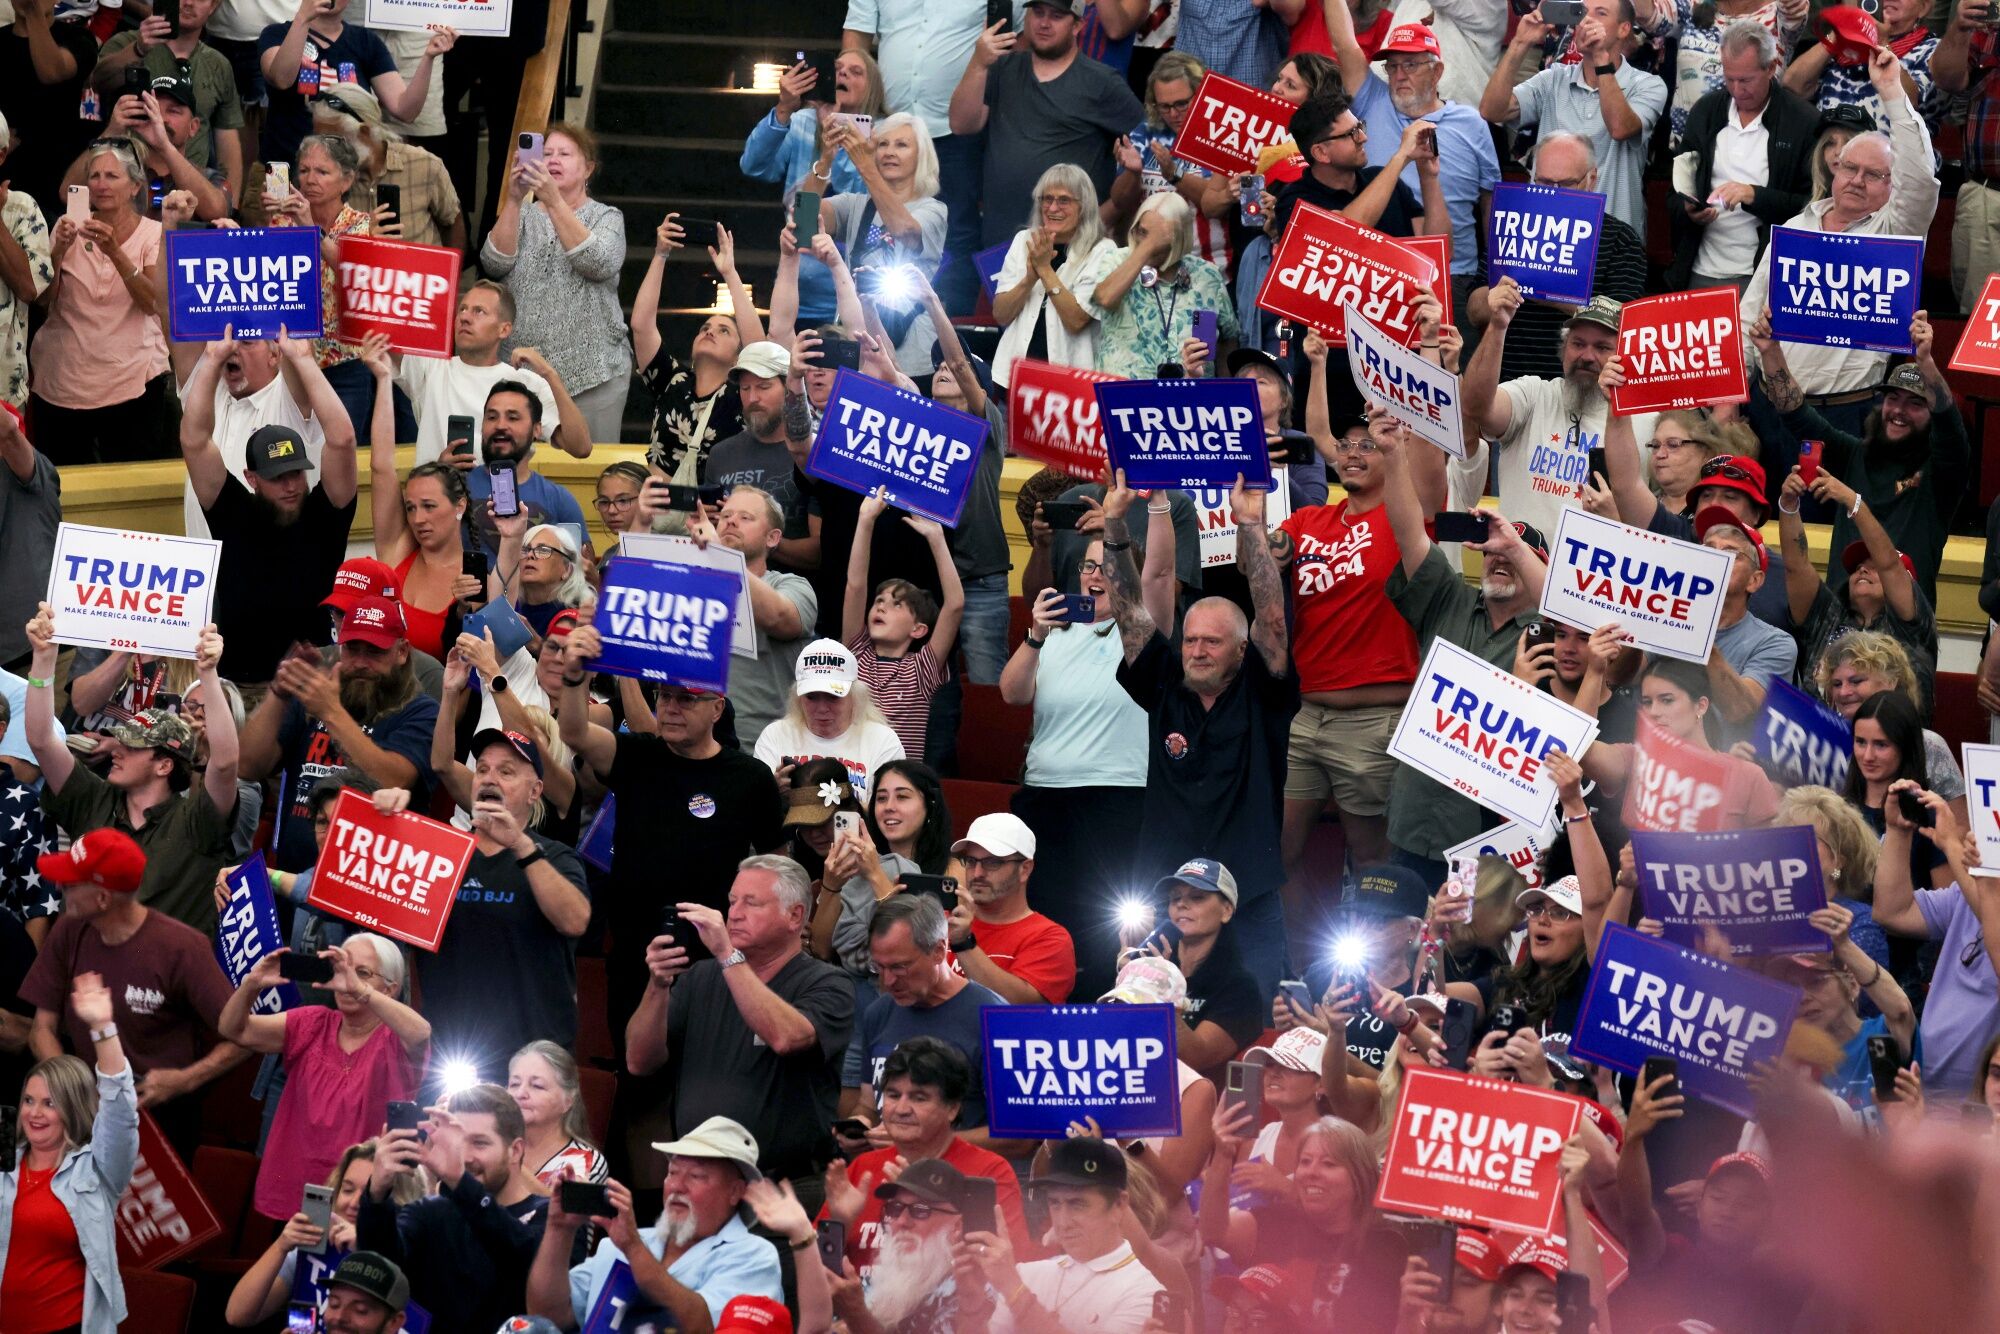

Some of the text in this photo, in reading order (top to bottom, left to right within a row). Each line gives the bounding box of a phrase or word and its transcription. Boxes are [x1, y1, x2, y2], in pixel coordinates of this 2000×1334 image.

[407, 1, 440, 9] AMERICA
[1204, 96, 1294, 146] TRUM
[1195, 136, 1248, 161] MAKE AMERICA
[1209, 122, 1264, 158] VAN
[1357, 227, 1384, 243] 2024
[1495, 211, 1592, 245] TRUMP
[1498, 237, 1575, 265] VANCE
[1503, 260, 1526, 268] AMERICA
[1529, 263, 1551, 272] GREAT
[1553, 267, 1578, 275] AGAIN!
[178, 256, 312, 283] TRUMP
[340, 262, 449, 300] TRUMP
[1302, 245, 1405, 302] VANCE
[1778, 256, 1910, 294] TRUMP
[195, 282, 299, 304] VANCE
[347, 289, 432, 320] VANCE
[1278, 264, 1410, 331] TRUMP
[1517, 285, 1534, 294] 024
[1789, 285, 1892, 315] VANCE
[1782, 307, 1898, 324] MAKE AMERICA GREAT AGAIN!
[1622, 317, 1732, 355] TRUMP
[1825, 335, 1851, 345] 2024
[1351, 329, 1451, 408] TRUMP
[1630, 345, 1722, 375] VANCE
[1360, 358, 1441, 422] VANCE
[1628, 368, 1730, 386] MAKE AMERICA GREAT AGAIN!
[1018, 383, 1100, 427] TRU
[1672, 397, 1694, 407] 2024
[839, 397, 972, 464] TRUMP
[1032, 410, 1108, 450] VAN
[1111, 406, 1253, 432] TRUMP
[846, 428, 950, 484] VANCE
[1133, 432, 1243, 452] VANCE
[721, 470, 764, 484] WEST
[832, 447, 950, 495] MAKE AMERICA GREAT AGAIN!
[1529, 445, 1590, 485] DEPLOR
[869, 486, 896, 502] 224
[1532, 477, 1570, 498] TRUMP
[65, 555, 205, 594] TRUMP
[1208, 553, 1232, 564] 2024
[1565, 537, 1715, 600] TRUMP
[76, 584, 184, 617] VANCE
[604, 585, 729, 628] TRUMP
[1563, 588, 1694, 632] MAKE AMERICA GREAT AGAIN!
[1576, 569, 1691, 620] VANCE
[65, 607, 190, 628] MAKE AMERICA GREAT AGAIN!
[610, 614, 711, 651] VANCE
[110, 639, 138, 648] 2024
[804, 656, 845, 667] TRUMP
[1435, 708, 1541, 783] VANCE
[1766, 705, 1852, 774] TRUM
[1419, 727, 1539, 796] MAKE AMERICA GREAT AGAIN!
[1453, 778, 1480, 798] 2024
[335, 818, 454, 883] TRUMP
[338, 849, 431, 904] VANCE
[1645, 859, 1808, 892] TRUMP
[376, 891, 401, 905] GREAT
[402, 901, 429, 916] AGAIN!
[484, 891, 515, 903] BJJ
[1668, 888, 1795, 916] VANCE
[354, 911, 378, 926] 2024
[1607, 960, 1777, 1043] TRUMP
[1600, 1021, 1629, 1037] MAKE
[1631, 1033, 1675, 1055] AMERICA
[1679, 1051, 1711, 1068] GREAT
[1617, 998, 1749, 1068] VANCE
[993, 1038, 1164, 1070] TRUMP
[1014, 1069, 1146, 1095] VANCE
[1008, 1096, 1156, 1106] MAKE AMERICA GREAT AGAIN!
[1407, 1103, 1562, 1160] TRUMP
[1416, 1139, 1536, 1187] VANCE
[1442, 1205, 1473, 1219] 2024
